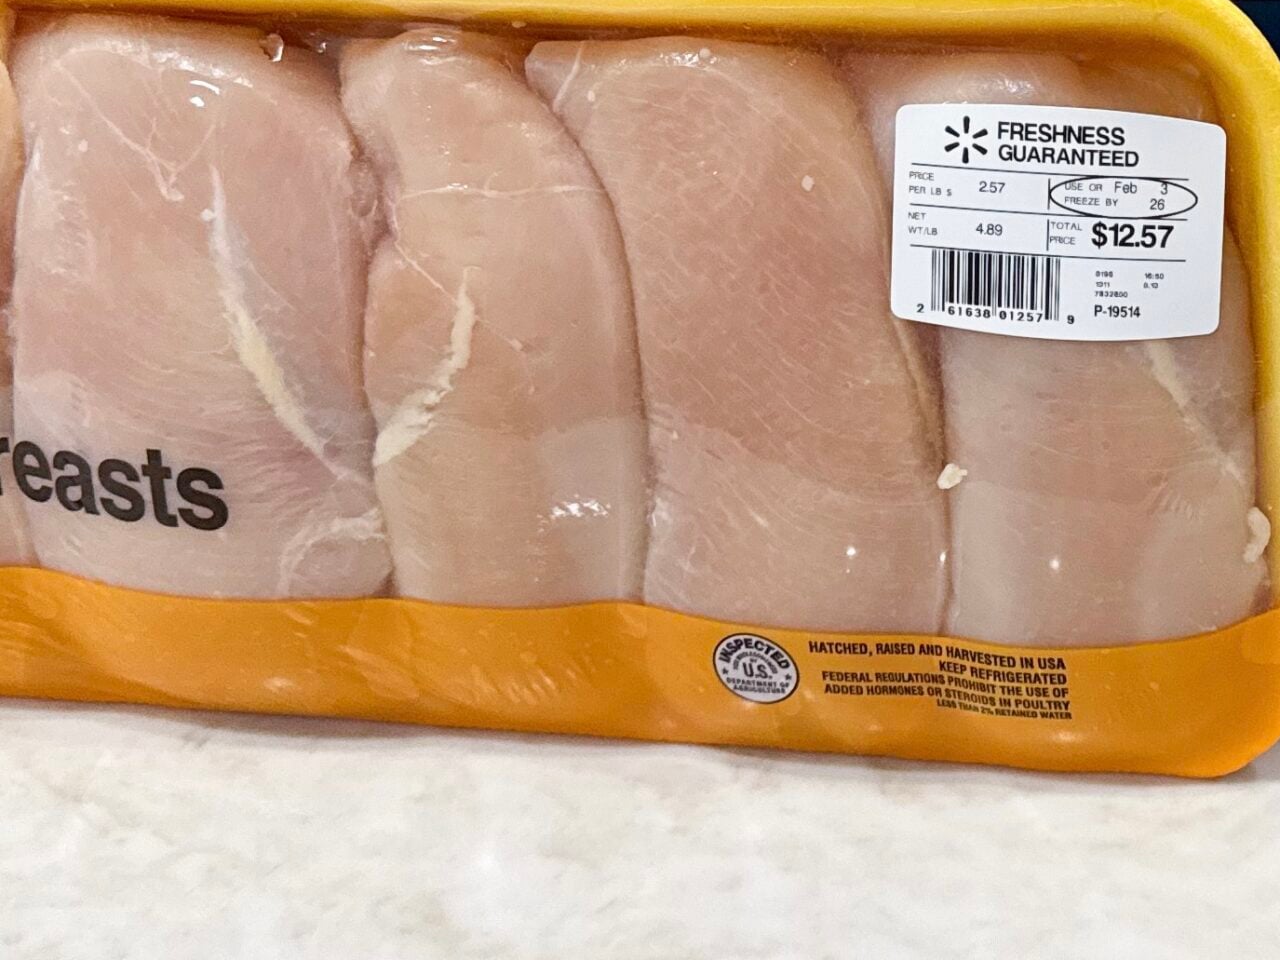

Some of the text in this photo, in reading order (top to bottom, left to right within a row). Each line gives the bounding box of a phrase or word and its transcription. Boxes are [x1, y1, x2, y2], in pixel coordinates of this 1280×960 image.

[997, 121, 1125, 146] FRESHNESS
[998, 144, 1139, 167] GUARANTEED
[908, 171, 935, 181] PRICE
[908, 185, 926, 194] PER
[930, 186, 942, 196] LB
[979, 180, 1005, 193] 2.57
[1064, 180, 1137, 194] USE OR Feb
[1160, 182, 1168, 196] 3
[1064, 196, 1119, 207] FREEZE BY
[1149, 198, 1165, 211] 26
[908, 212, 927, 221] NET
[908, 226, 938, 236] WT/LB
[975, 223, 1003, 236] 4.89
[1050, 221, 1082, 231] TOTAL
[1049, 235, 1076, 246] PRICE
[1091, 221, 1174, 249] $12.57
[916, 303, 1076, 325] 2 61638 01257 9
[1094, 304, 1141, 318] P-19514
[719, 638, 790, 669] INSPECTED
[808, 640, 1066, 670] HATCHED, RAISED AND HARVESTED IN USA
[742, 661, 773, 679] U.S.
[939, 660, 1067, 685] KEEP REFRIGERATED
[726, 677, 777, 688] DEPARTMENT
[733, 684, 786, 694] AGRICULTURE
[822, 670, 1069, 698] FEDERAL REGULATIONS PROHIBIT THE USE OF
[824, 683, 1070, 711] ADDED HORMONES OR STEROIDS IN POULTRY
[937, 699, 1072, 719] LESS THAN 2% RETAINED WATER
